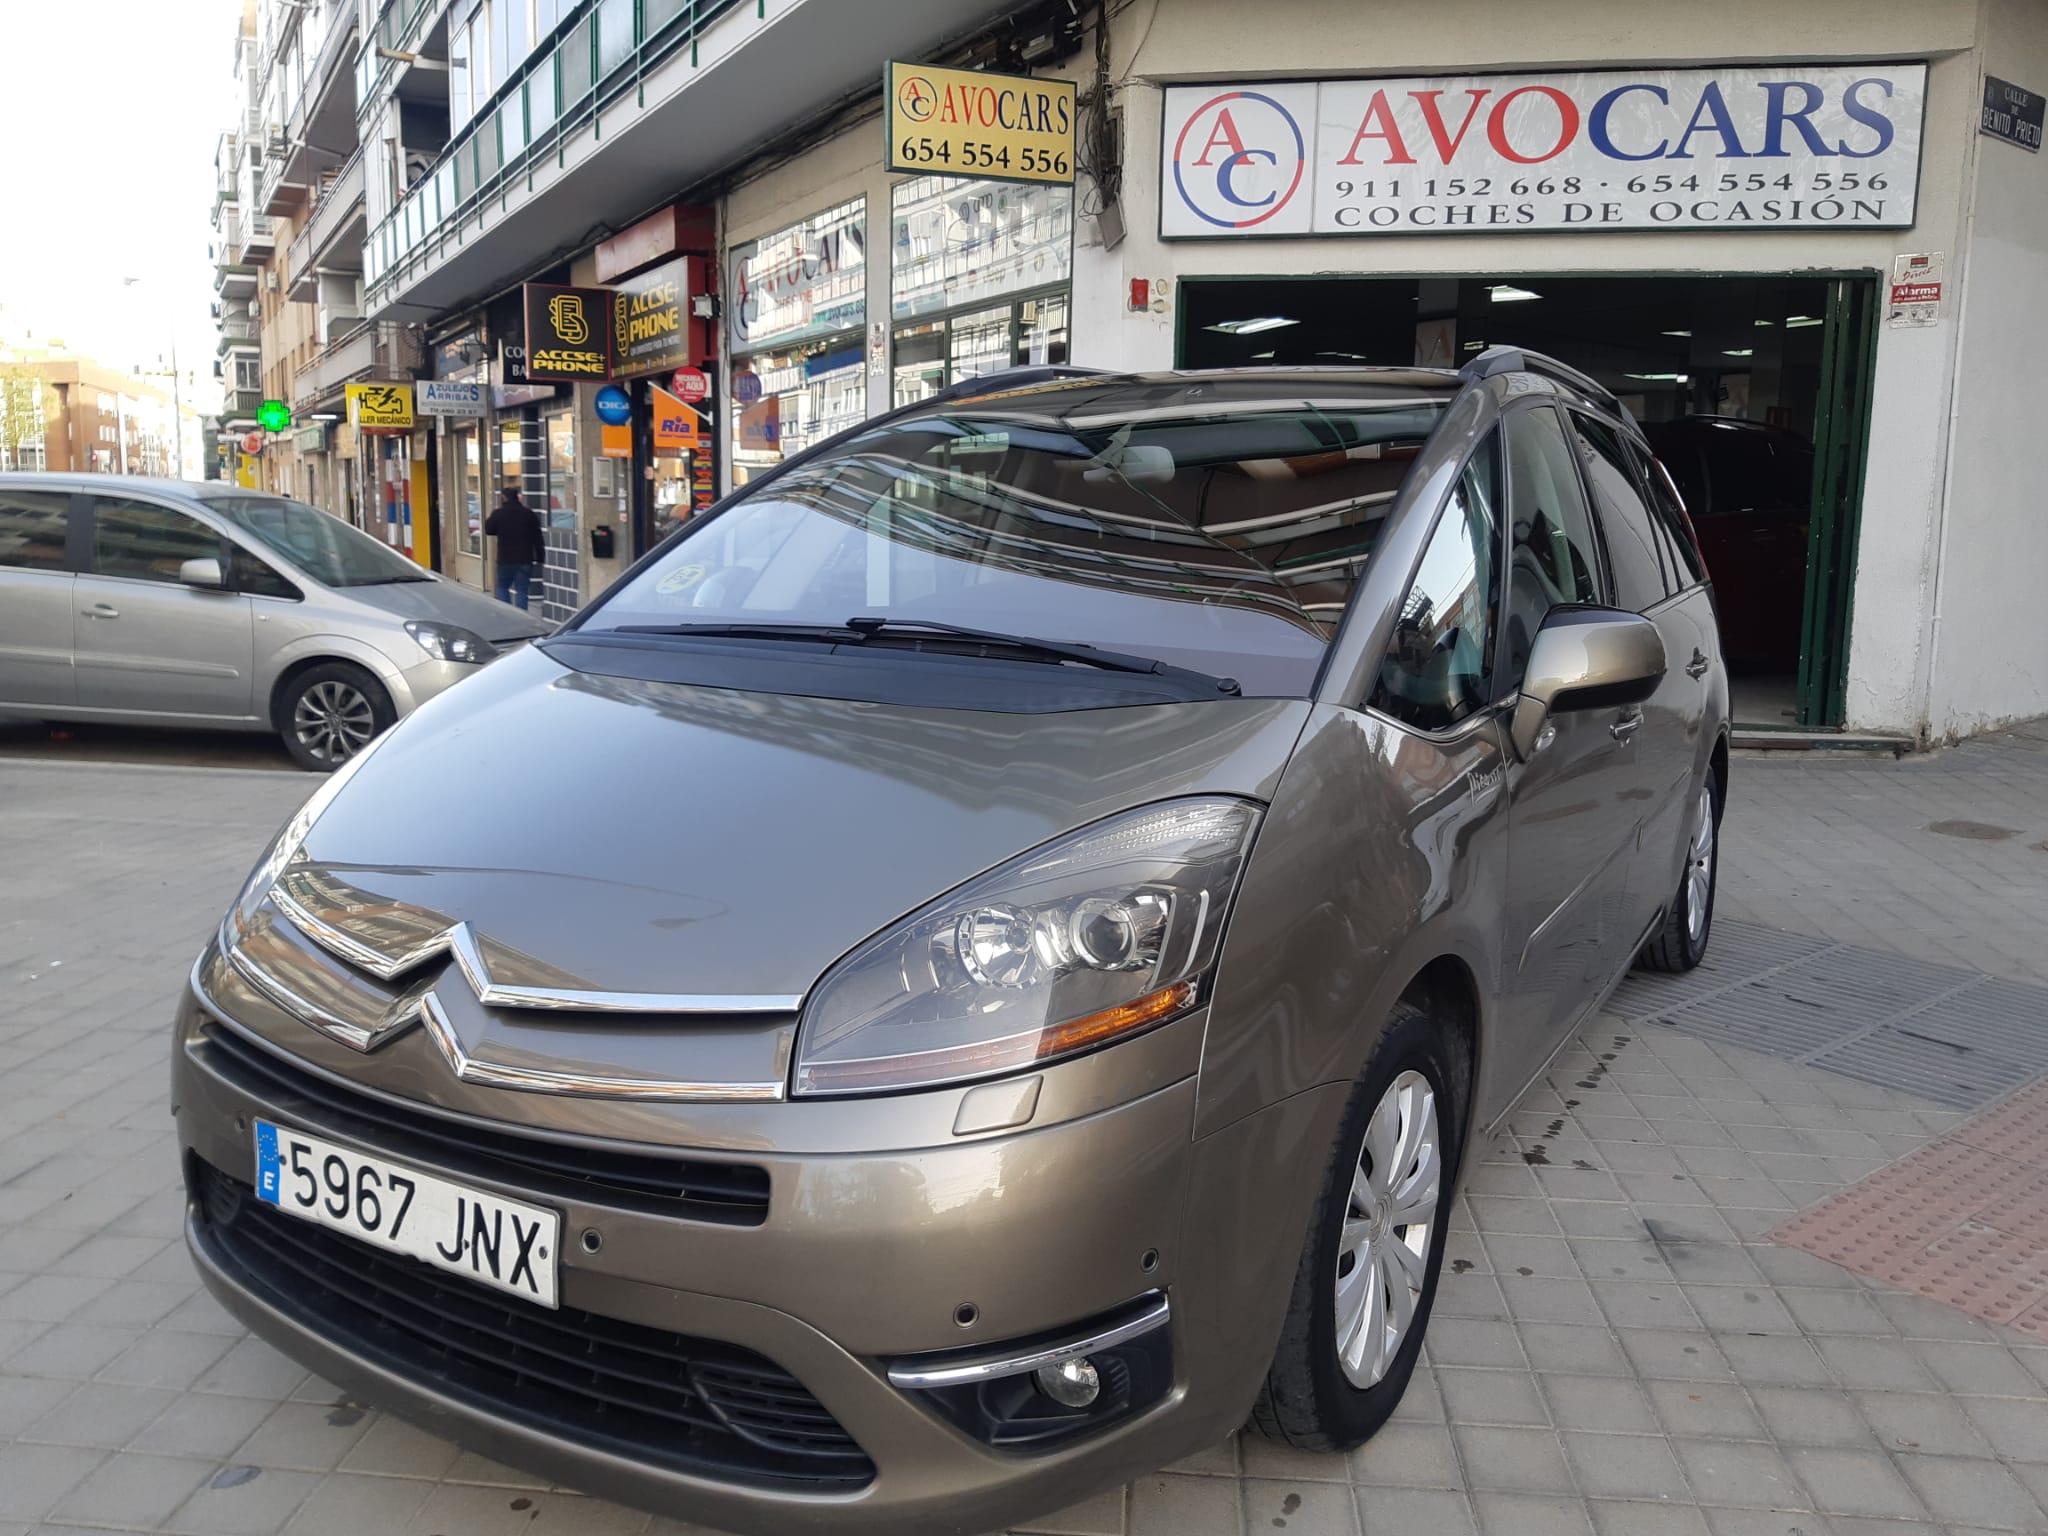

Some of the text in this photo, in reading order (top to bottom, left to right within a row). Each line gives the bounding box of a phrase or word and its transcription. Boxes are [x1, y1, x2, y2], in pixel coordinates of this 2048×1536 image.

[2005, 87, 2028, 107] CALLE
[940, 83, 1068, 135] AVOCARS
[1336, 78, 1894, 165] AVOCARS
[1983, 107, 2041, 145] BENITO PRIETO
[901, 136, 1068, 175] 654 554 556
[1336, 172, 1888, 199] 911 152 668 654 554 556
[1334, 194, 1887, 227] COCHES DE OCASIÓN
[1895, 286, 1938, 297] Alarma
[629, 307, 679, 342] PHONE
[533, 360, 605, 374] PHONE
[534, 350, 606, 362] ACCSE+
[597, 401, 630, 410] DIGI
[359, 415, 411, 425] LLER MECÁNICO
[661, 416, 691, 433] Ria
[263, 1172, 274, 1192] E
[290, 1141, 541, 1294] 5967 JNX
